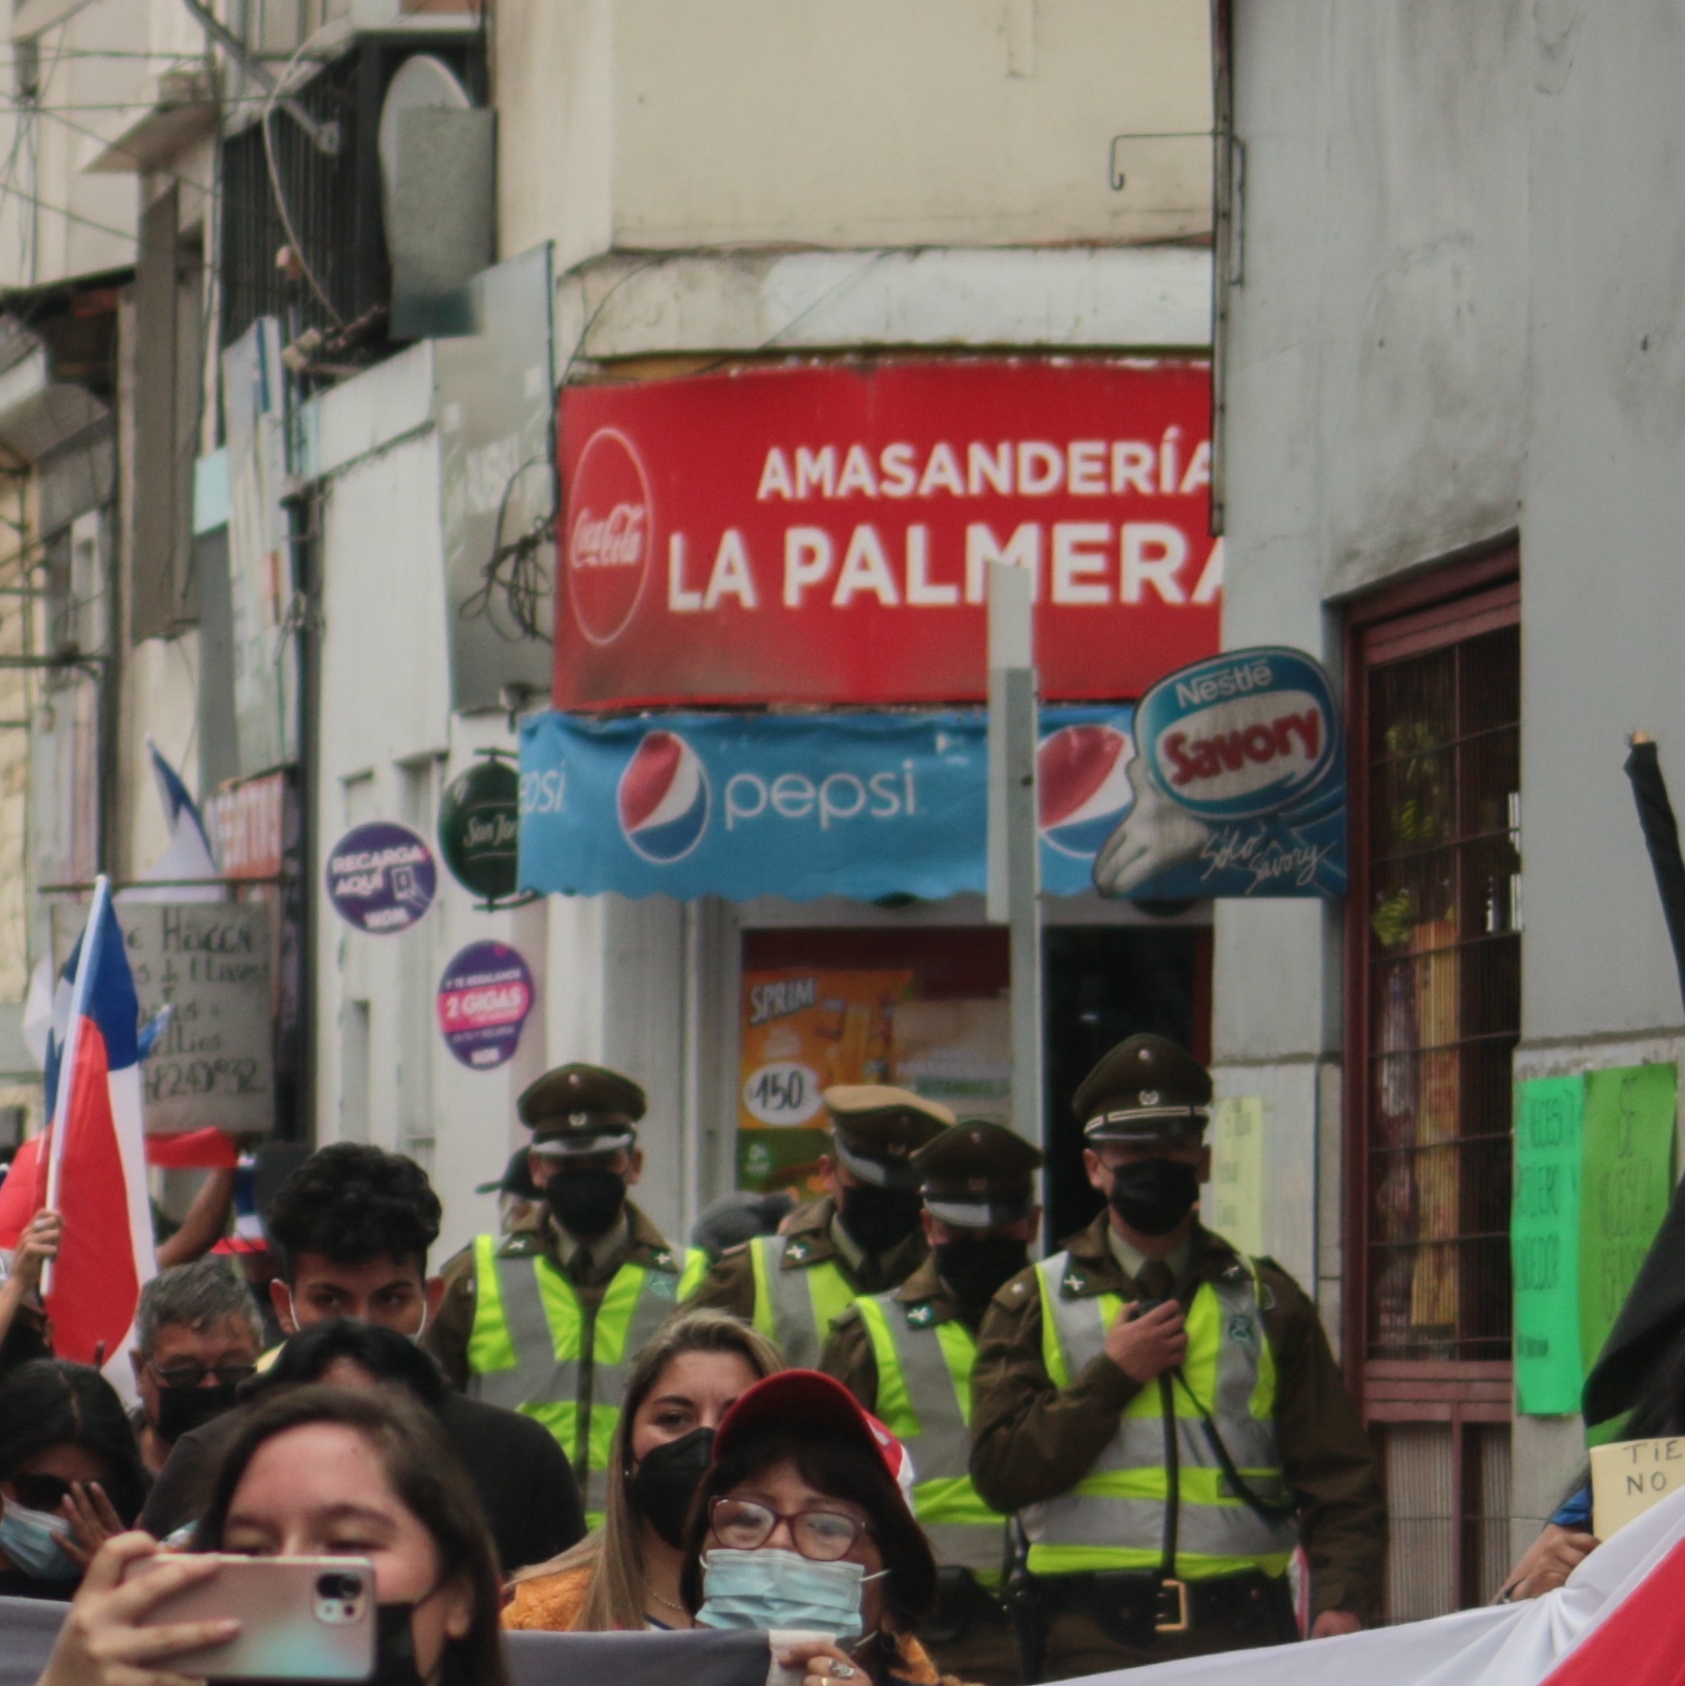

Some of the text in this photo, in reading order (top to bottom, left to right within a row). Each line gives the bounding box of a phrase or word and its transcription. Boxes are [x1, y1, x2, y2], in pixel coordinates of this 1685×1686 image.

[757, 424, 1212, 500] AMASANDERÍA
[669, 528, 759, 613] LA
[1163, 707, 1320, 786] Savory
[725, 758, 918, 831] pepsi
[331, 846, 425, 874] RECARGA
[445, 995, 459, 1019] 2
[1626, 1470, 1667, 1496] NO
